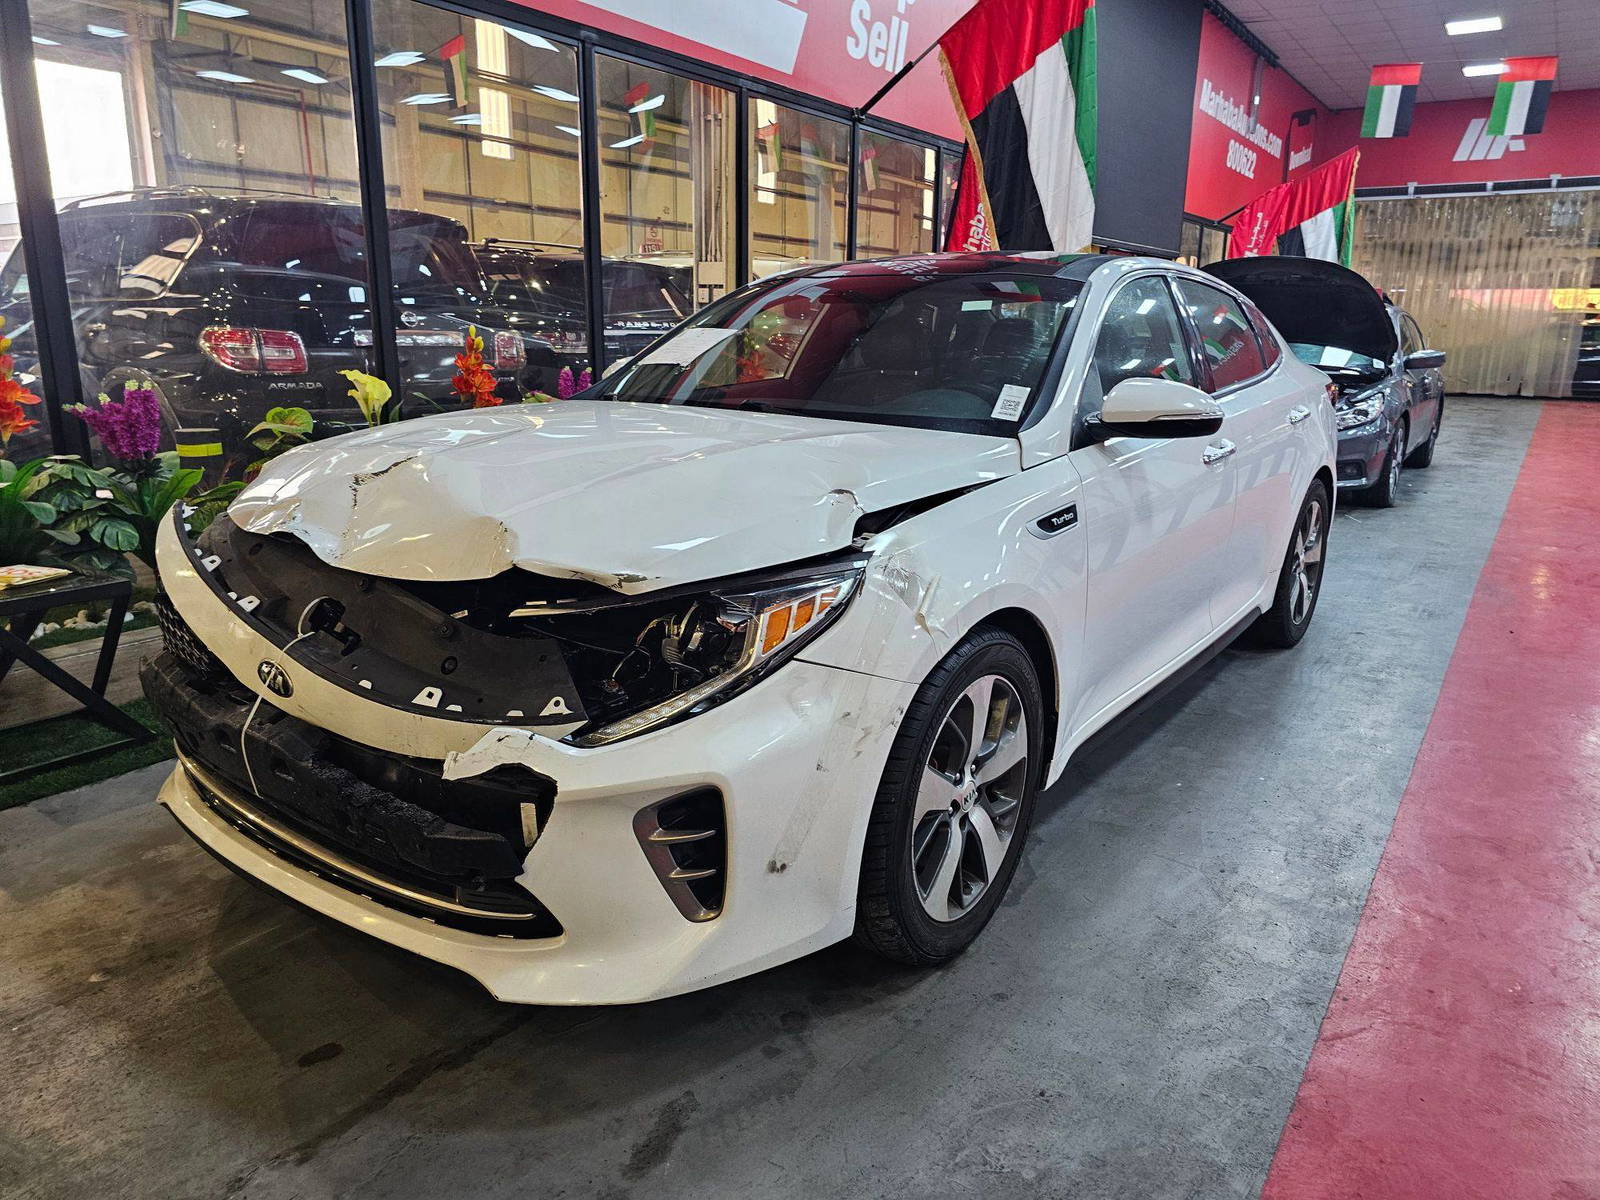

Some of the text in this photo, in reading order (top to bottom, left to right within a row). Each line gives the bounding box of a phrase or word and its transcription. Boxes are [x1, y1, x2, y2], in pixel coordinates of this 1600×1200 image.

[847, 0, 909, 74] Sell
[268, 382, 324, 390] ARMADA
[1051, 512, 1074, 526] Turbo
